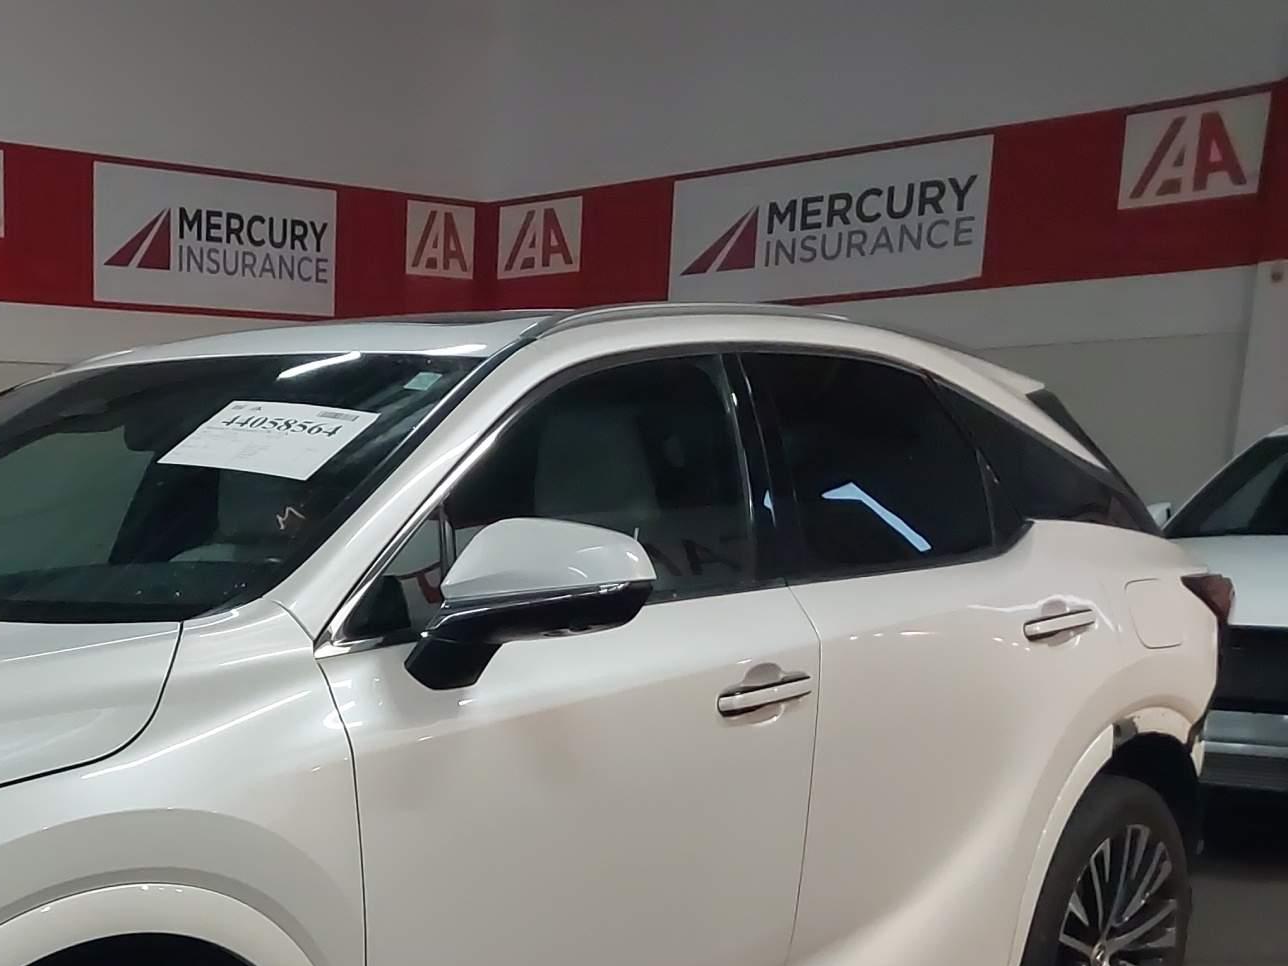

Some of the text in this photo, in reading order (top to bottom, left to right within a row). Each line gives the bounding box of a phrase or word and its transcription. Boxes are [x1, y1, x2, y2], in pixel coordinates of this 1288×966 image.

[766, 174, 979, 235] MERCURY
[177, 206, 329, 253] MERCURY
[763, 215, 976, 268] INSURANCE
[177, 244, 330, 285] INSURANCE
[221, 415, 343, 438] 44058564
